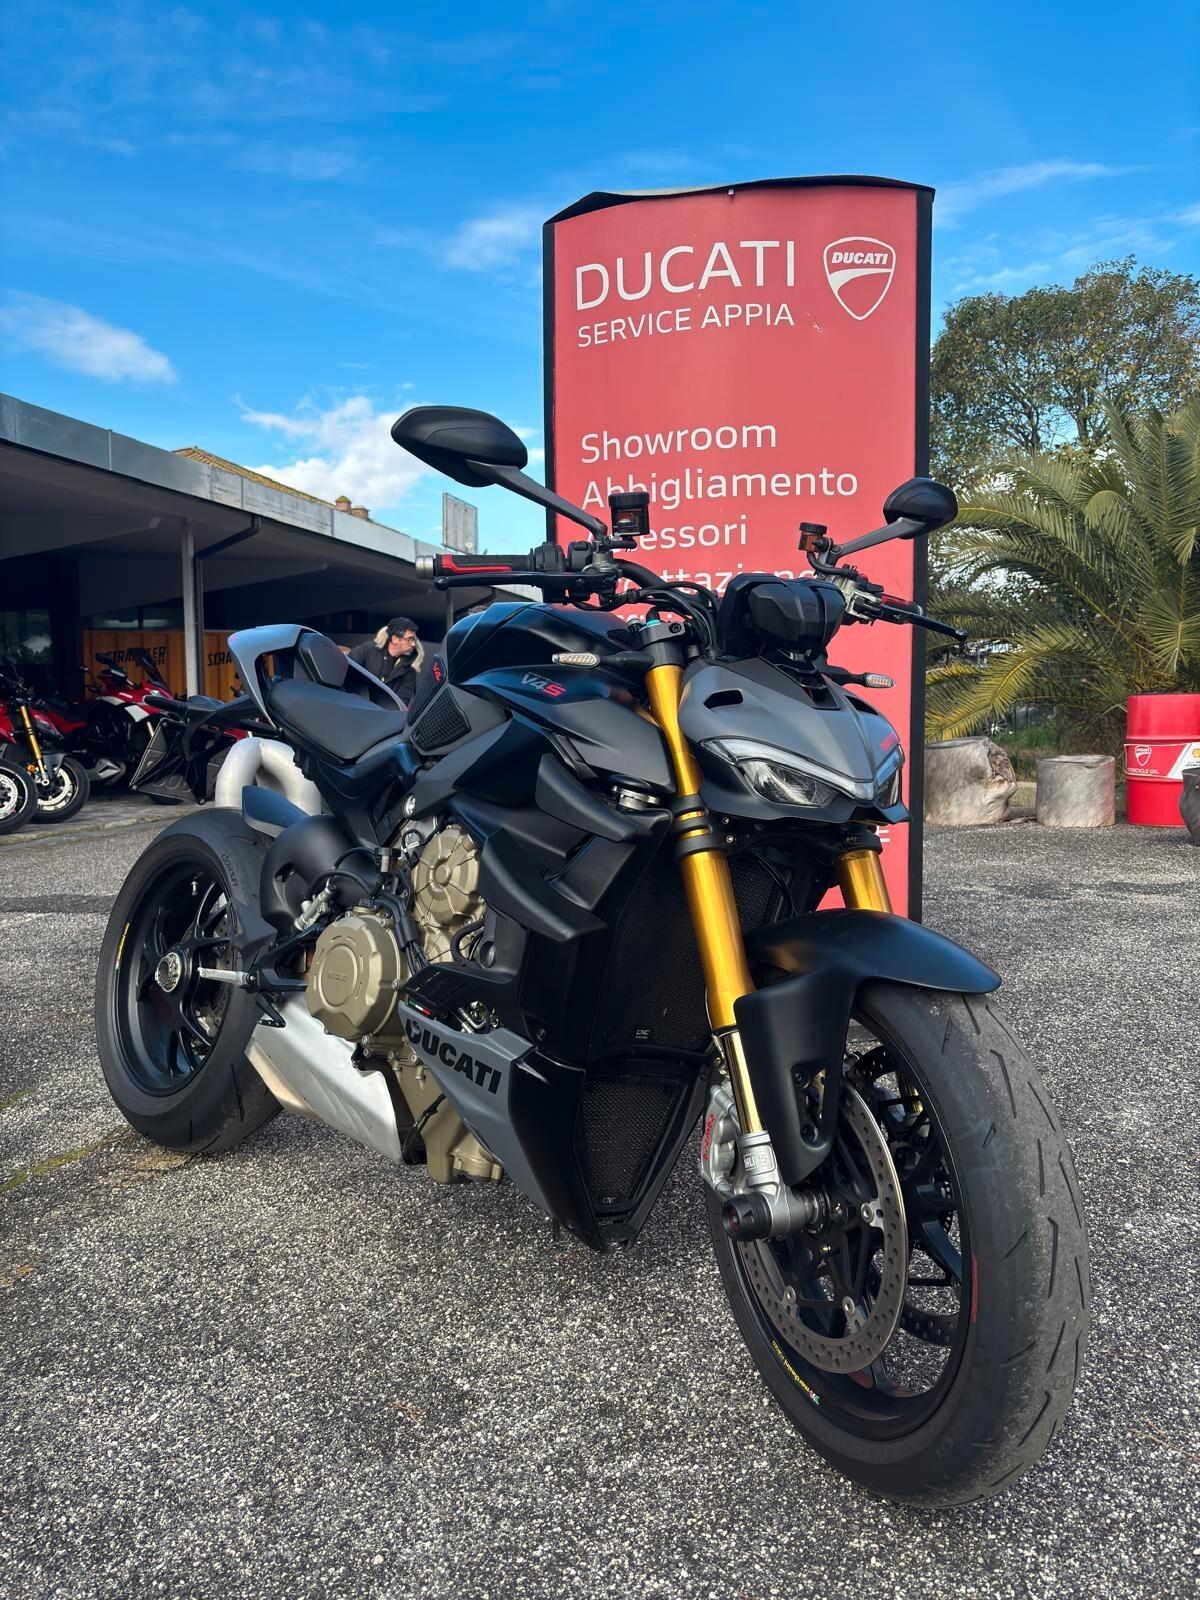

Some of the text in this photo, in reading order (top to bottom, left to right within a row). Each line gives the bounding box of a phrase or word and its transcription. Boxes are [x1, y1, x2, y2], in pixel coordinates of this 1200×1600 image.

[575, 240, 795, 311] DUCATI
[831, 252, 889, 265] DUCATI
[577, 303, 795, 348] SERVICE APPIA
[581, 423, 777, 464] Showroom
[521, 673, 567, 698] V4S
[405, 1018, 502, 1095] DUCATI
